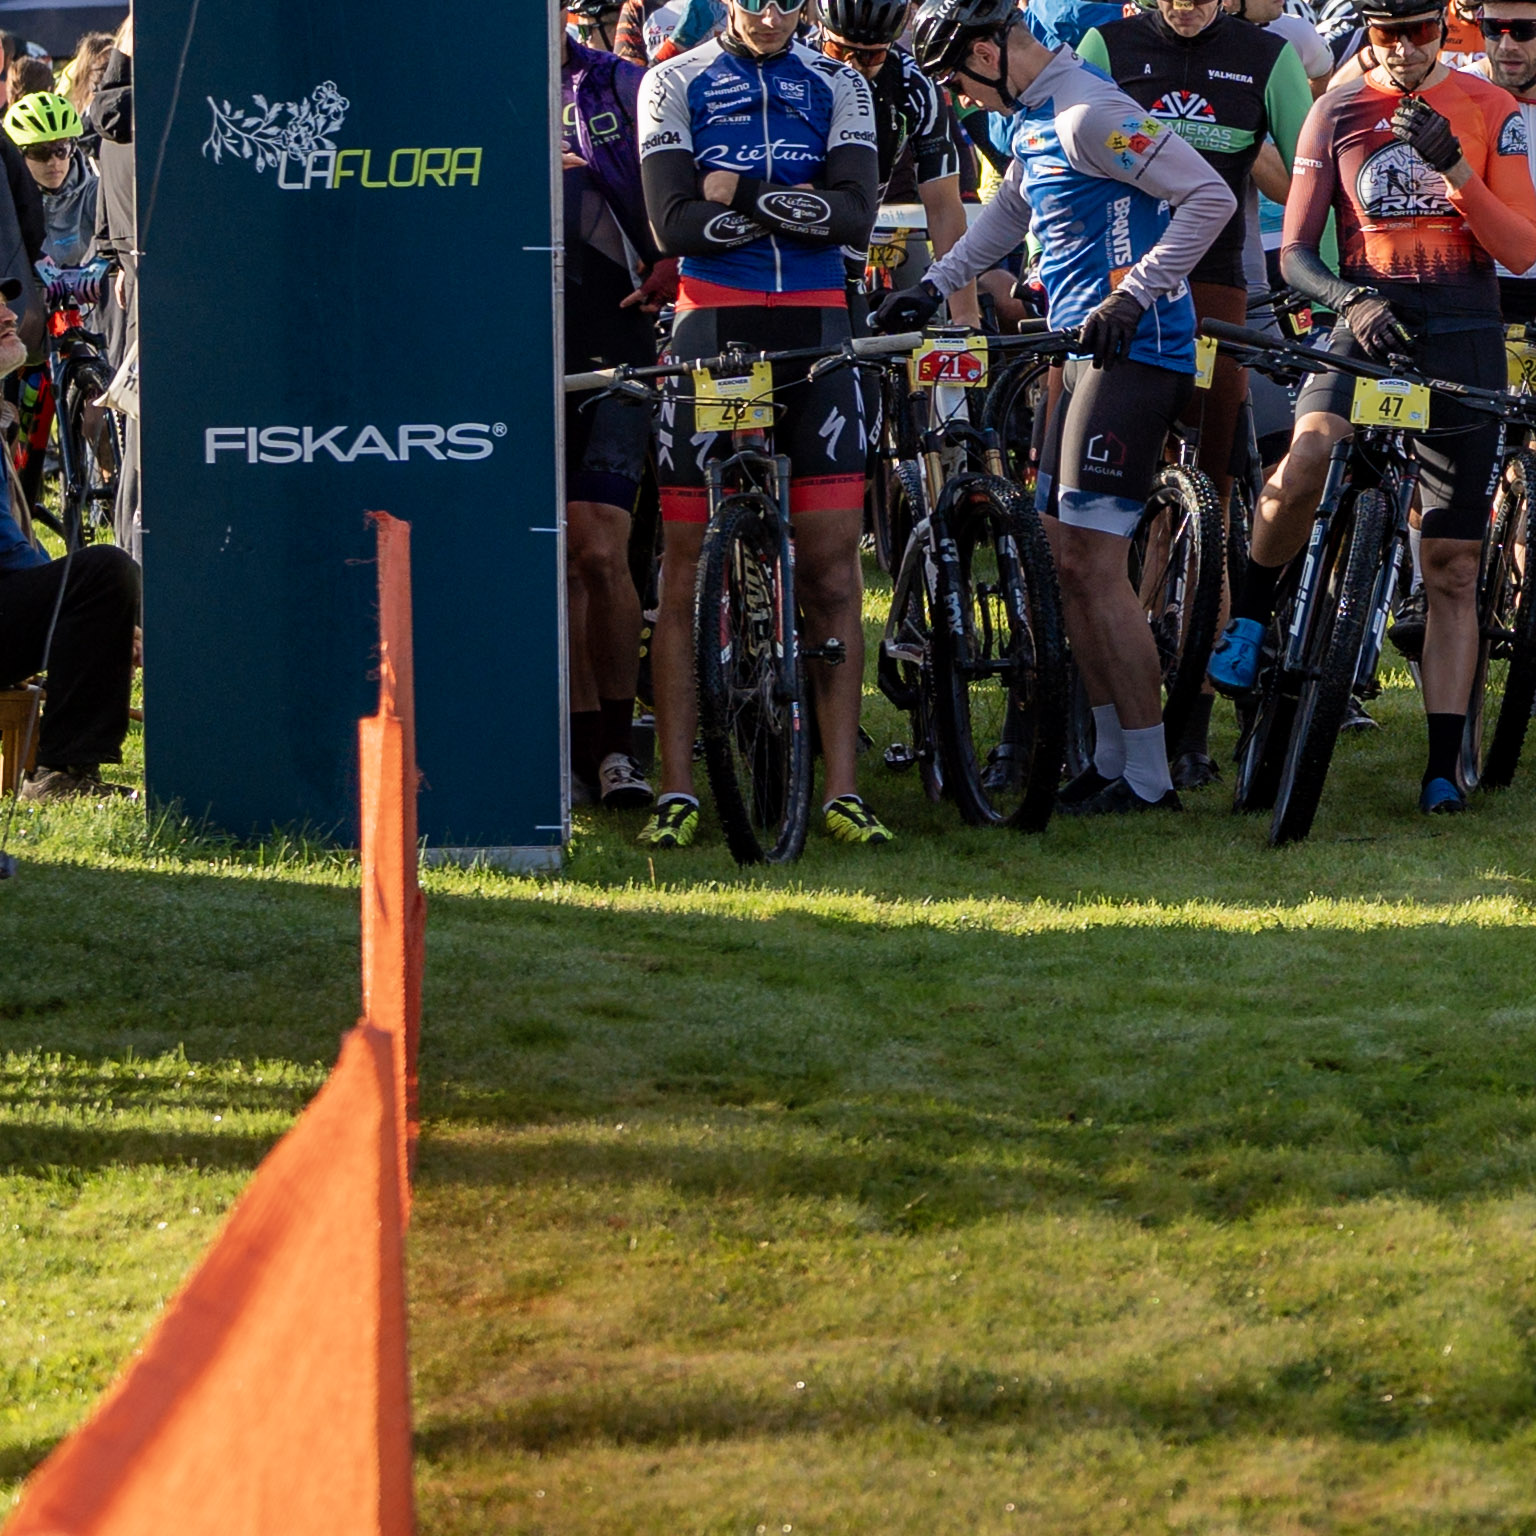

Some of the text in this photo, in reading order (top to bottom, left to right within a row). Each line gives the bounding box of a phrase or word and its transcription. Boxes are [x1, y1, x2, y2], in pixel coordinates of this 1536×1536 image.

[1208, 69, 1253, 85] VALMIERA
[840, 129, 877, 142] Credit
[1167, 120, 1232, 140] MIERAS
[641, 131, 682, 154] redit24
[276, 147, 483, 190] LAFLORA
[938, 355, 961, 378] 21
[1378, 395, 1404, 418] 47
